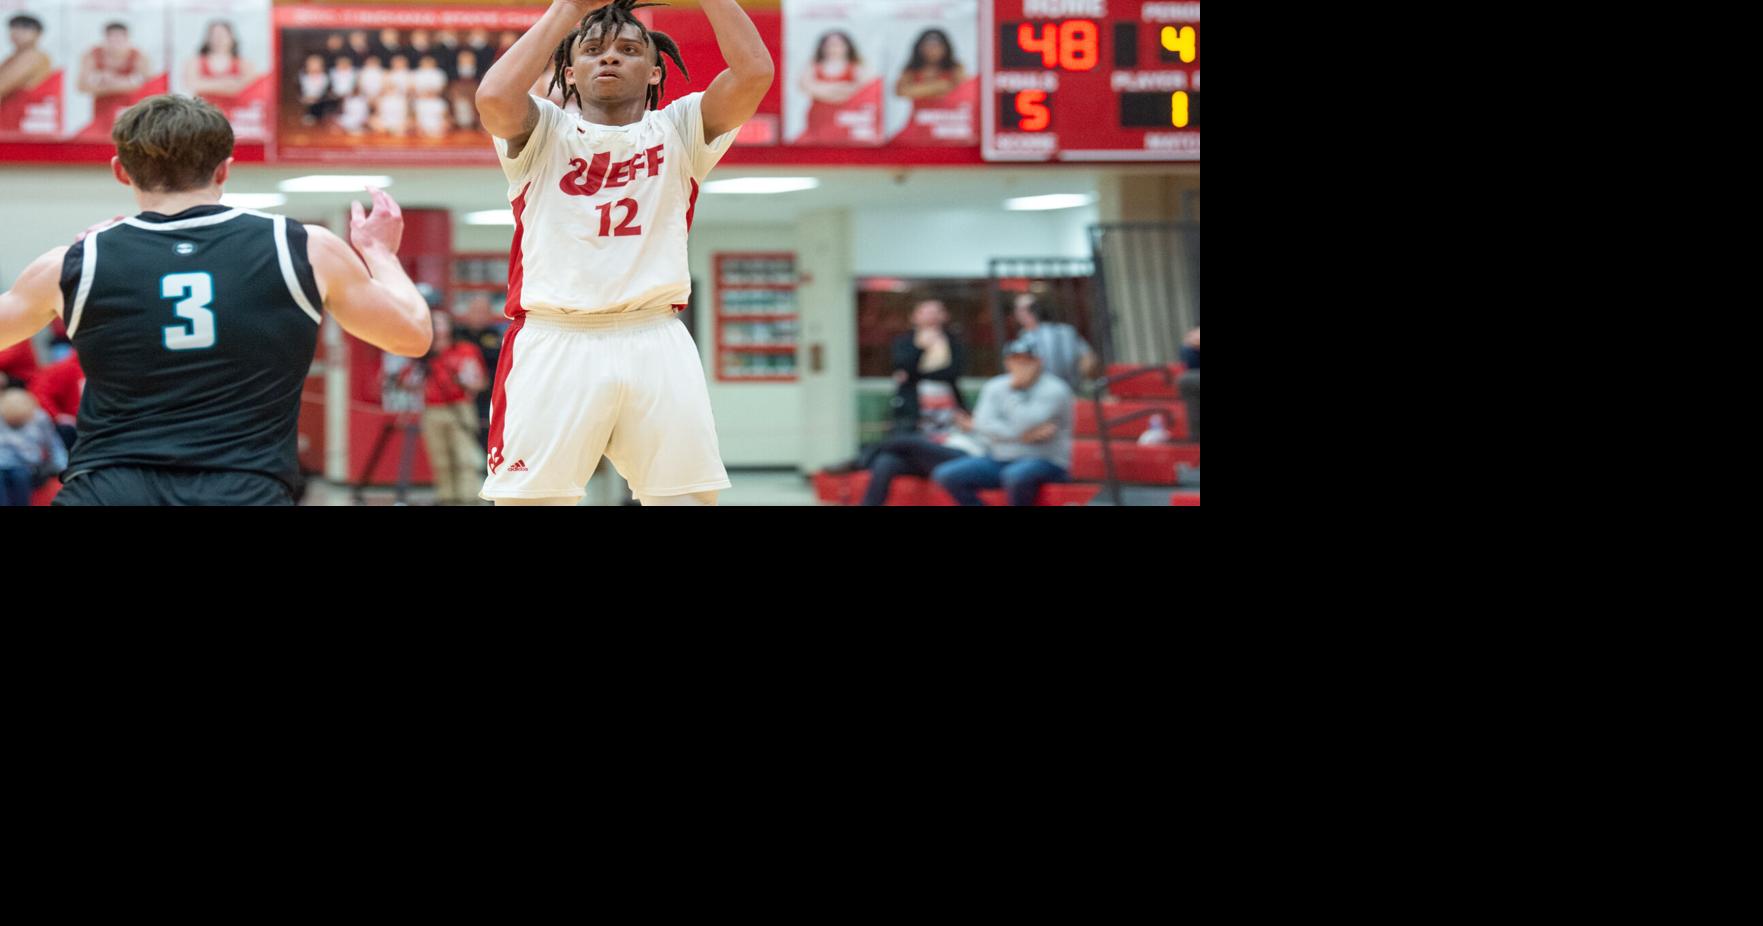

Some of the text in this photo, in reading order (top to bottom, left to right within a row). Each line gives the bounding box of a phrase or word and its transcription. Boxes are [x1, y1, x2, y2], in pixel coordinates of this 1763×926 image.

[1017, 19, 1099, 71] 48
[1161, 26, 1196, 63] 4
[1015, 89, 1051, 131] 5
[1172, 91, 1188, 128] 1
[559, 143, 665, 196] JEFF
[595, 197, 642, 237] 12
[160, 271, 216, 350] 3
